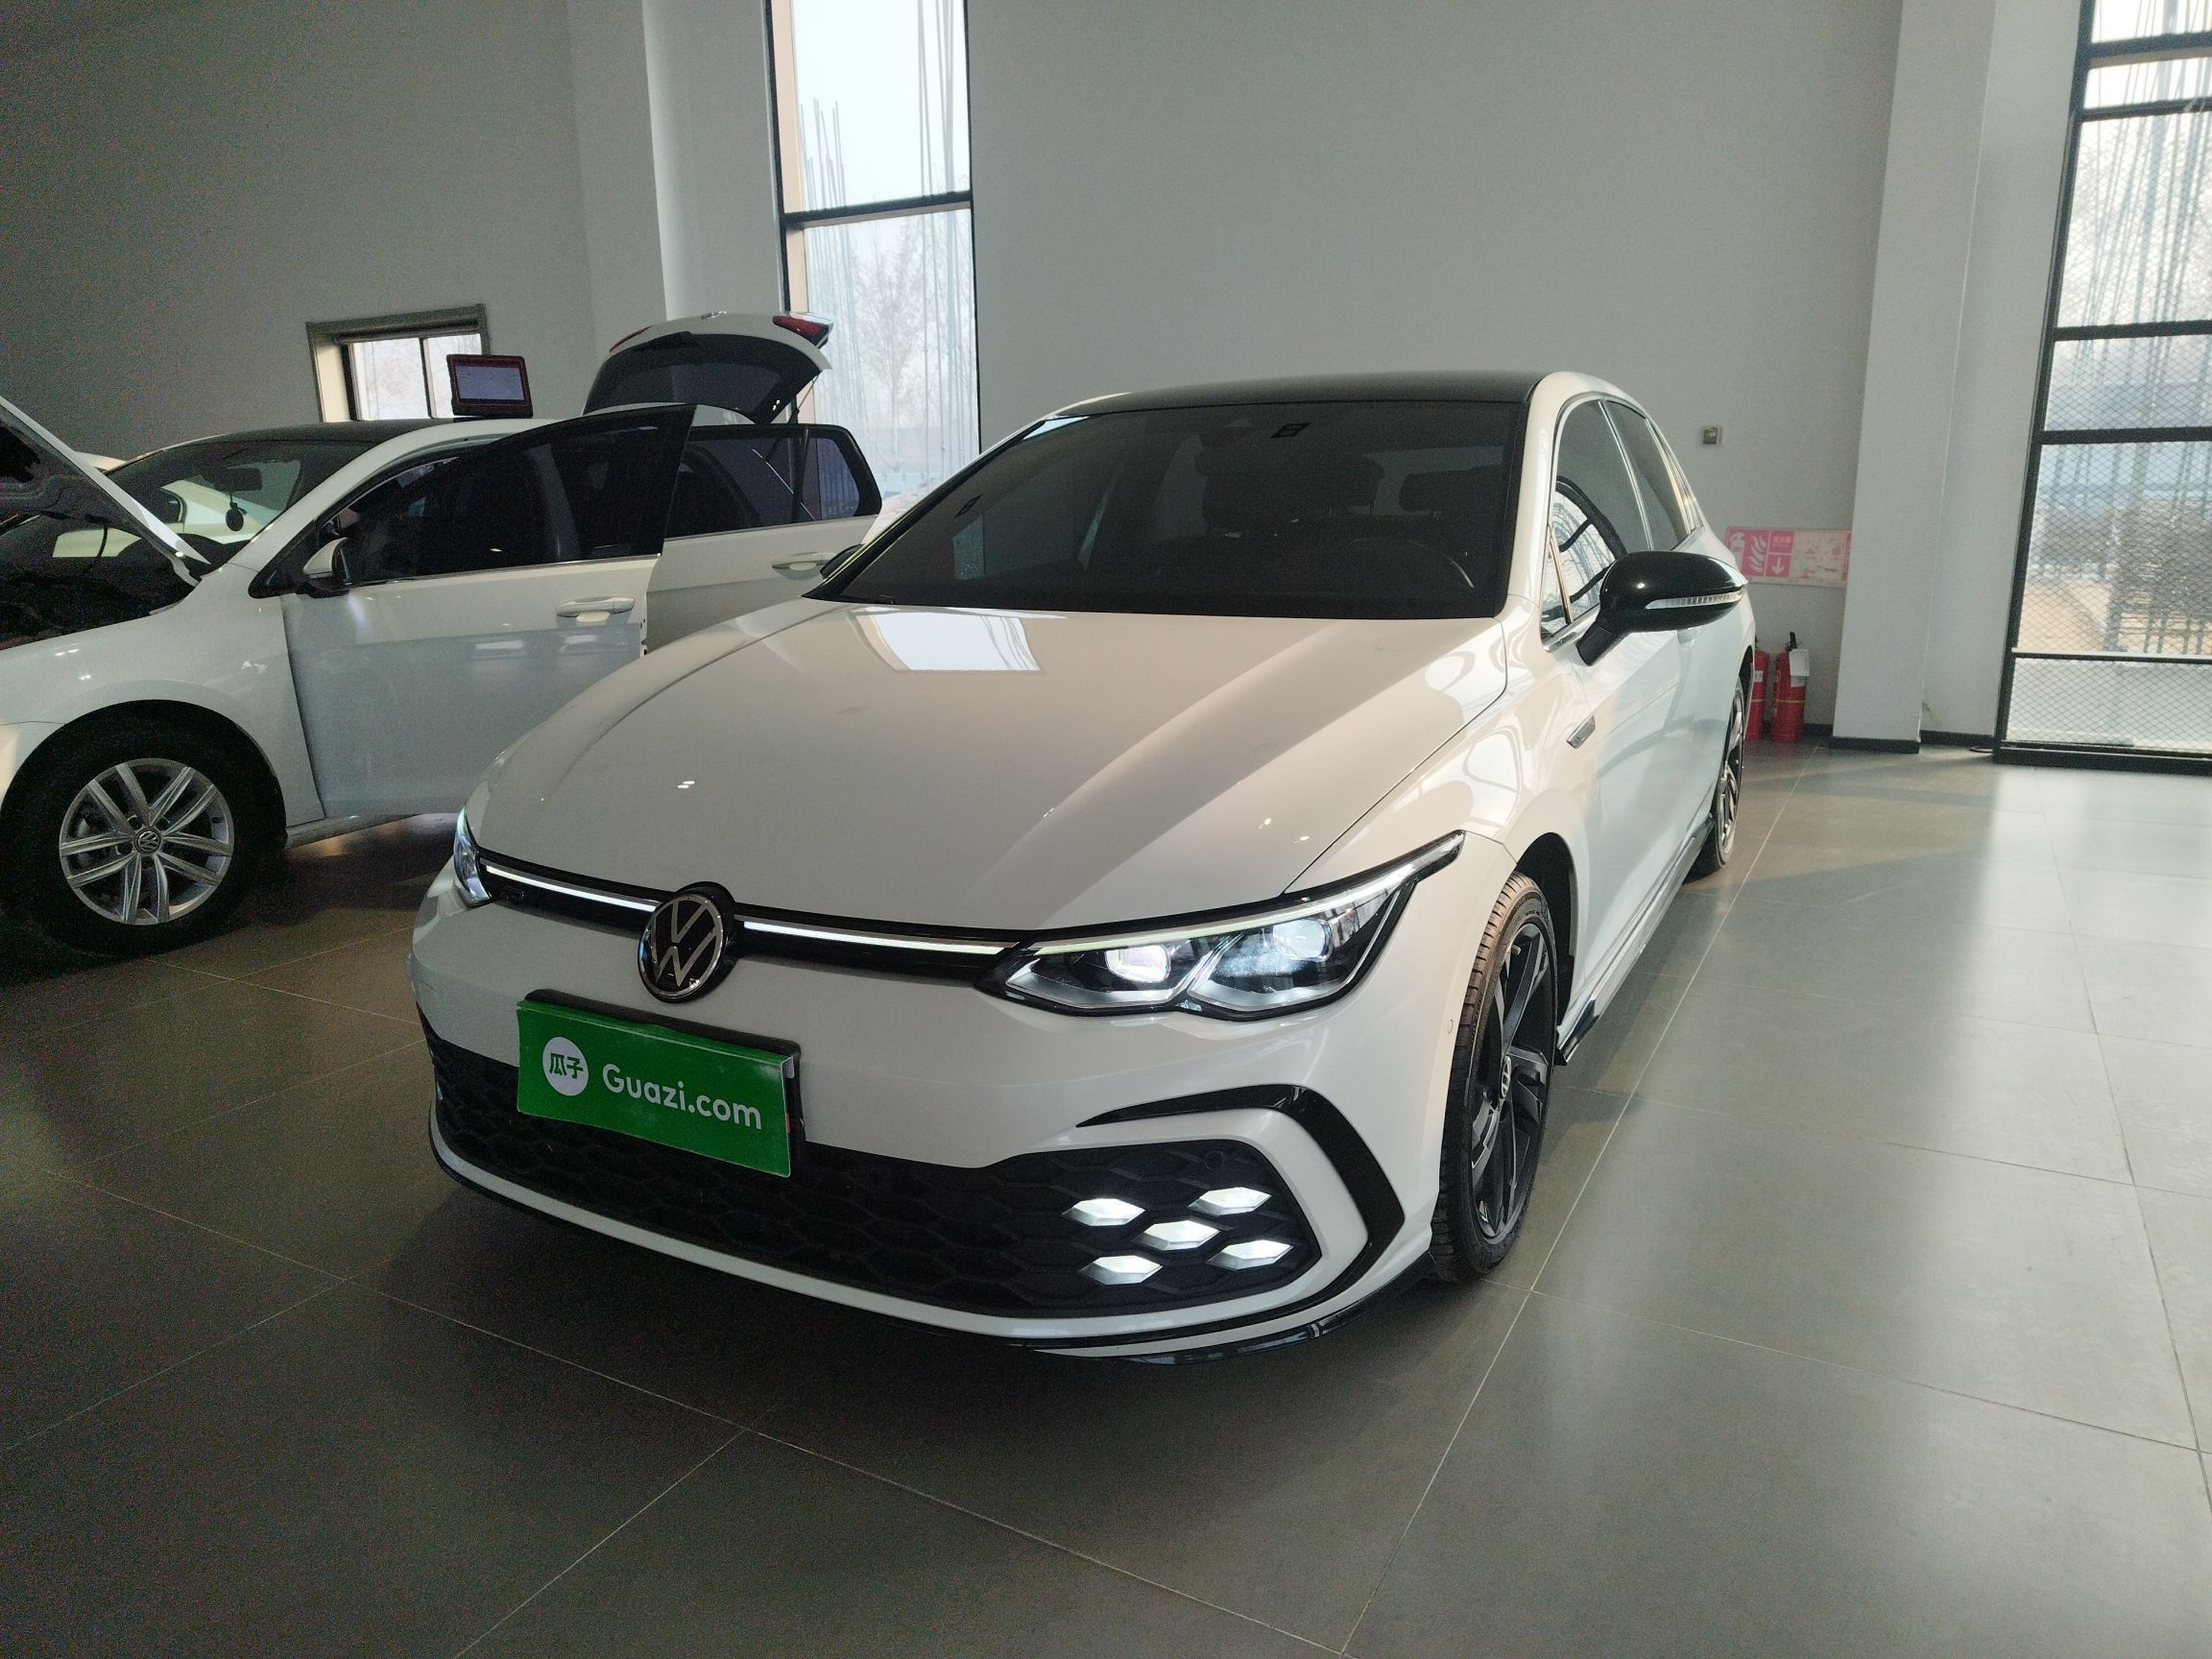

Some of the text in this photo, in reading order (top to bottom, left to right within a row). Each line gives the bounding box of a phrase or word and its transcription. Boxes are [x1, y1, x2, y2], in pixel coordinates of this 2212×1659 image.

[645, 894, 721, 989] VW
[548, 1052, 584, 1079] 瓜子
[602, 1063, 762, 1130] Guazi.com
